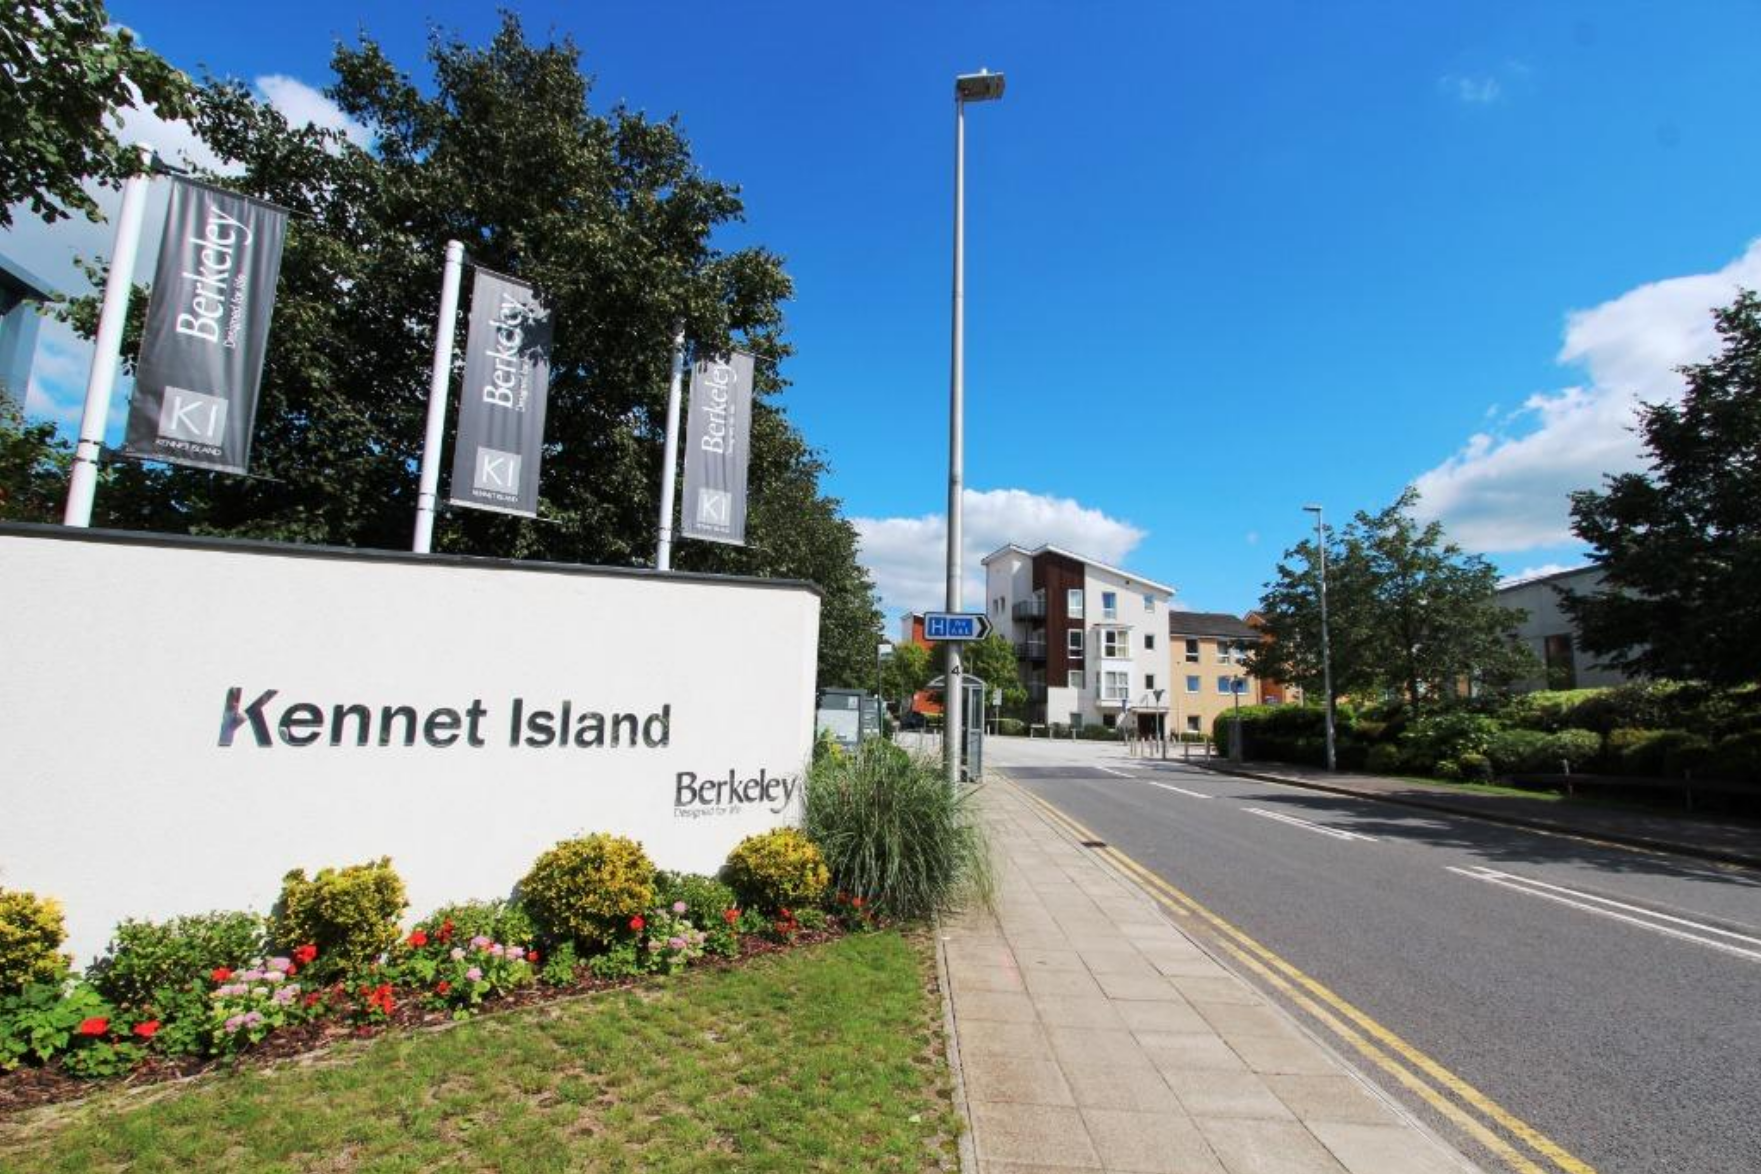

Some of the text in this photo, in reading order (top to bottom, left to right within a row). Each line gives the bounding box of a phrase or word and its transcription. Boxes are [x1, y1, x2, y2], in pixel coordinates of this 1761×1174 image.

[176, 205, 252, 343] Berkeley
[482, 293, 535, 408] Berkeley
[170, 395, 218, 438] KI
[701, 352, 737, 454] Berkeley
[482, 455, 514, 487] KI
[703, 494, 725, 520] KI
[931, 620, 944, 635] H
[951, 665, 960, 676] 4
[218, 687, 671, 748] Kennet Island
[674, 768, 798, 814] Berkeley
